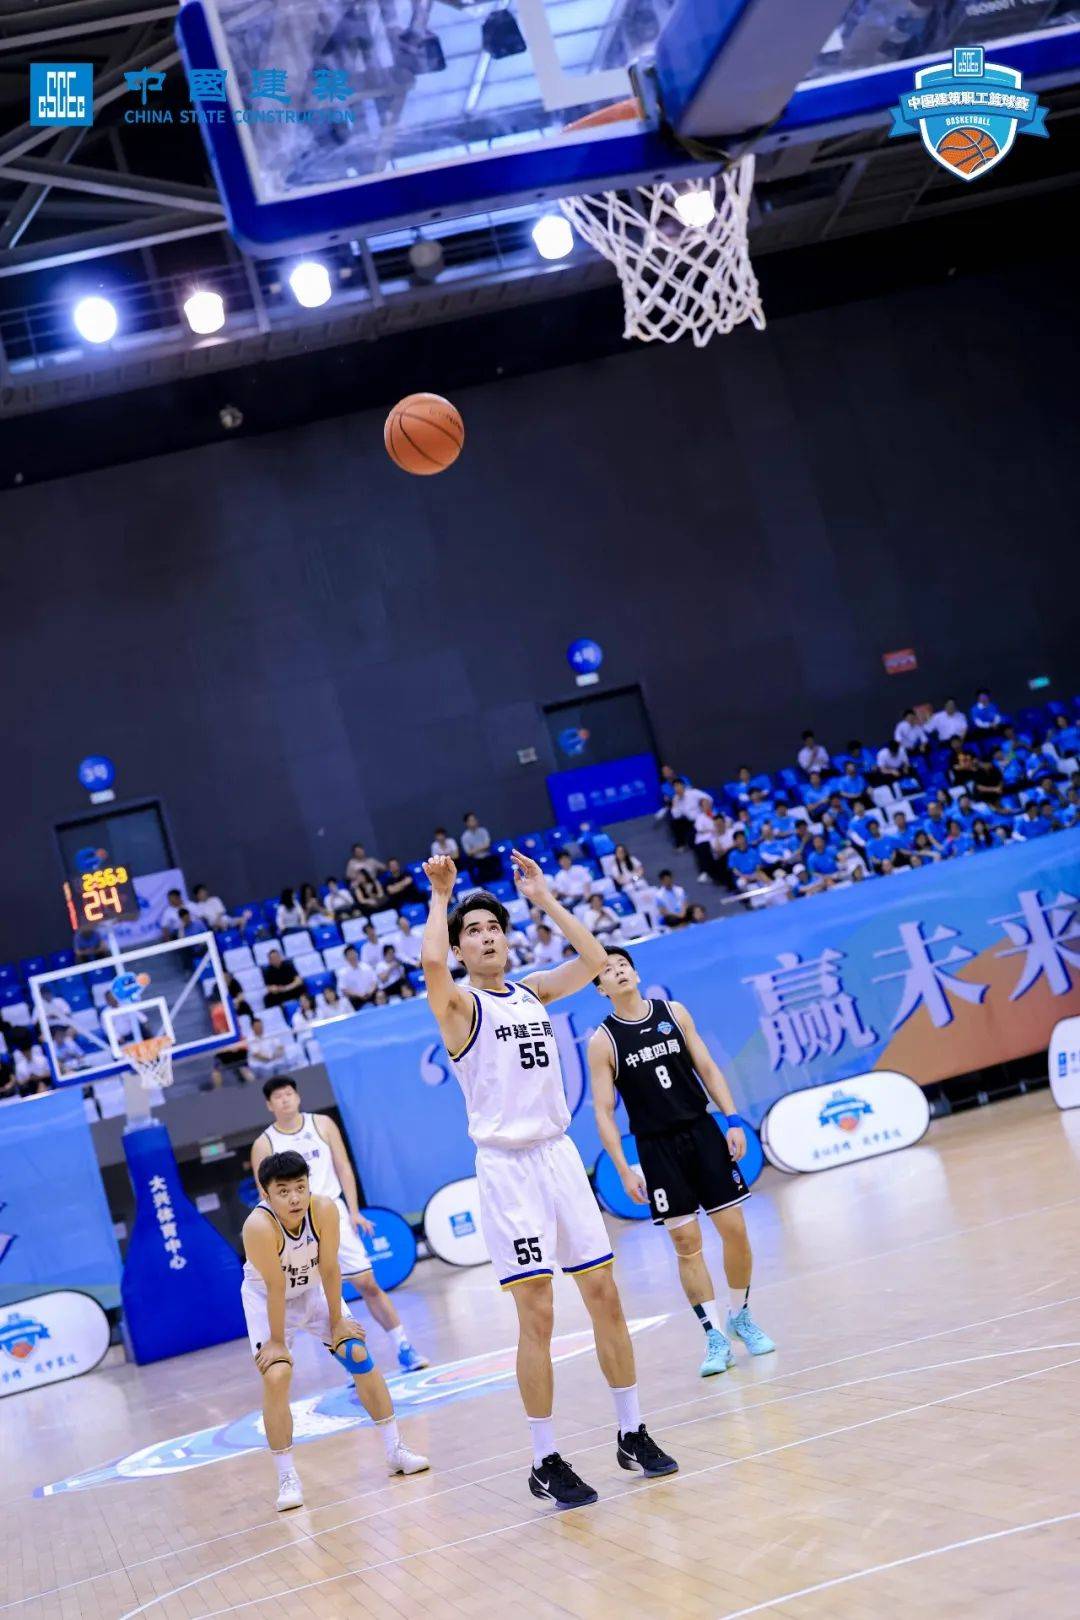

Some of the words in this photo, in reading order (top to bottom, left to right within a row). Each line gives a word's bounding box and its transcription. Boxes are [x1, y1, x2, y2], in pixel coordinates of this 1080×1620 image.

[82, 886, 122, 921] 24
[740, 889, 1080, 1073] 赢未来
[494, 1021, 554, 1042] 中建三局
[518, 1041, 550, 1069] 55
[625, 1038, 681, 1068] 中建四局
[655, 1064, 672, 1089] 8
[653, 1187, 670, 1213] 8
[148, 1173, 188, 1270] 大兴体育中心
[513, 1236, 542, 1266] 55
[289, 1275, 309, 1288] 13
